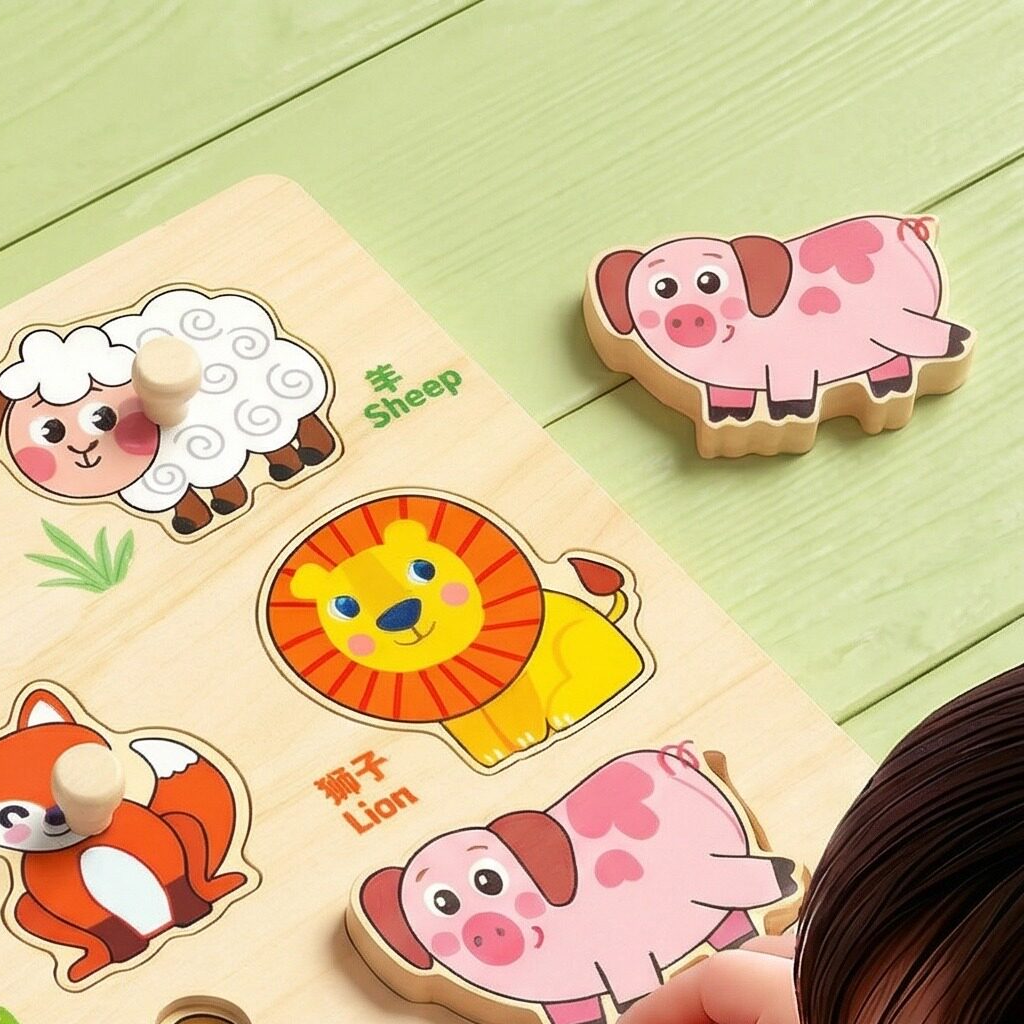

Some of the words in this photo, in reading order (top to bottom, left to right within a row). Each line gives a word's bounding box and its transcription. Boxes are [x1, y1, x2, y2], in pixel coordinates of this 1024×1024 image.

[364, 363, 404, 393] 羊
[364, 369, 463, 429] Sheep
[342, 786, 419, 836] Lion
